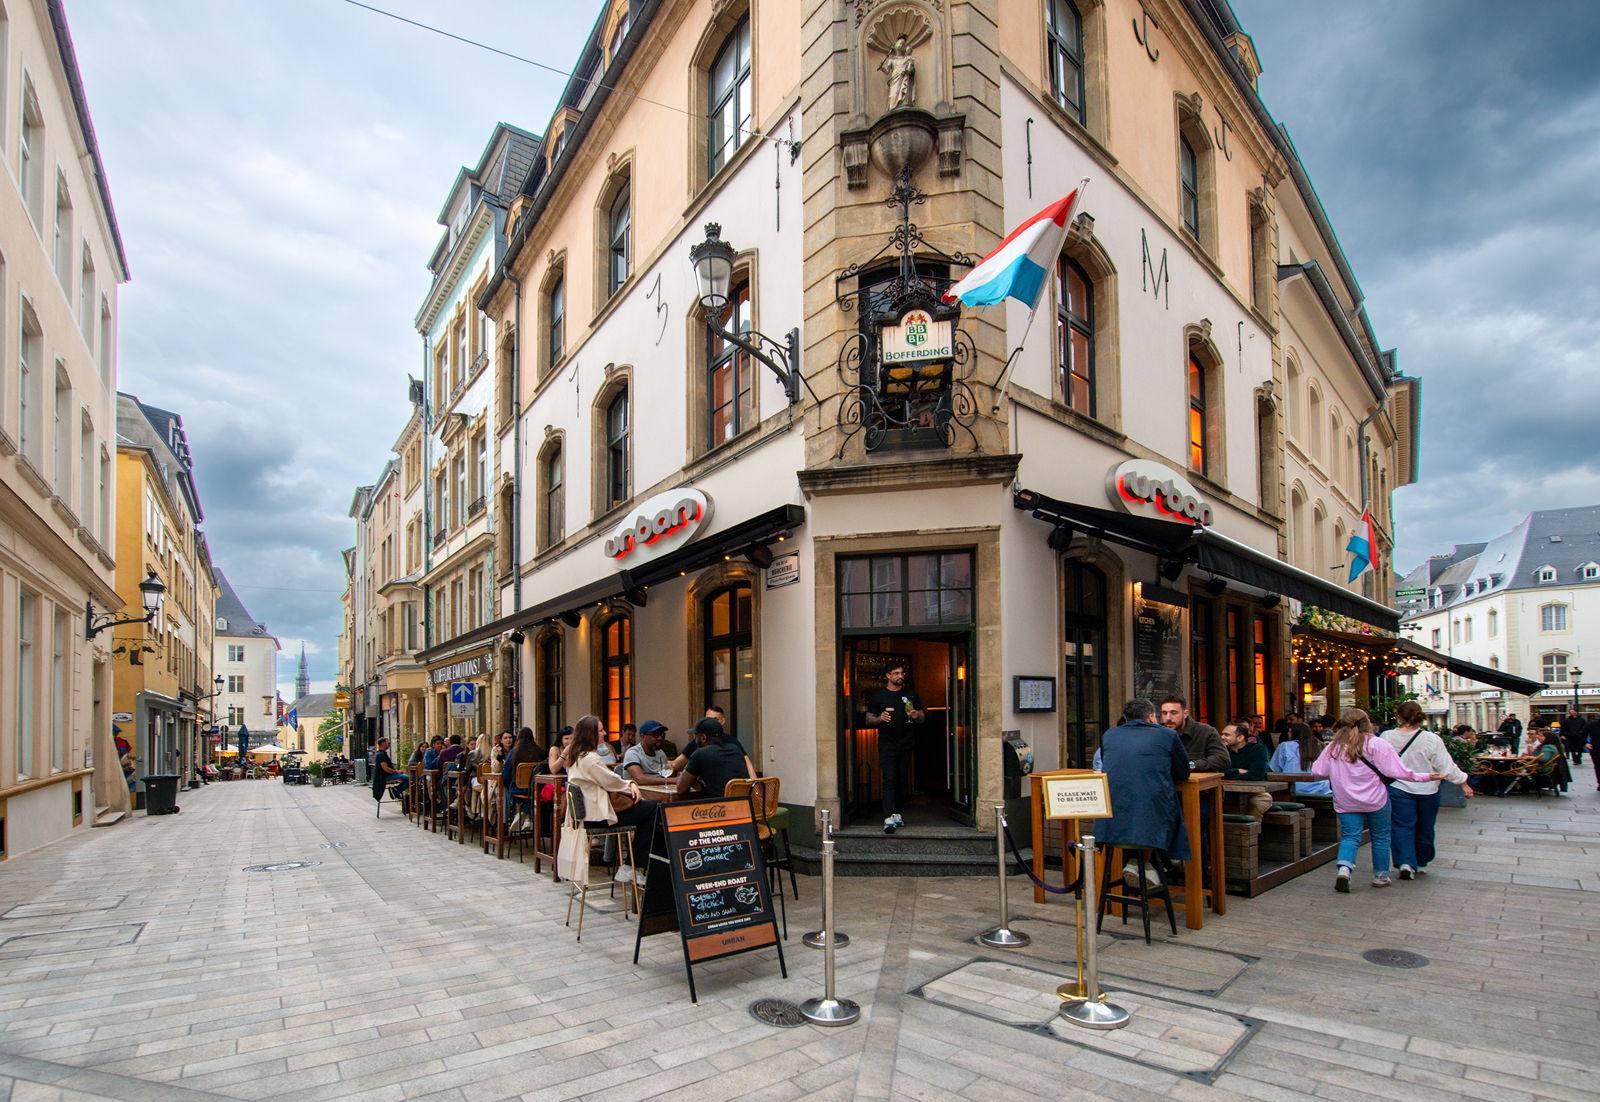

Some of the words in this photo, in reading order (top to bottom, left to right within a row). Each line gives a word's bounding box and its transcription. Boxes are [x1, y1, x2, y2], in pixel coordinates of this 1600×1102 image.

[885, 347, 949, 360] BOFFERDING
[1124, 471, 1214, 527] urban
[604, 498, 698, 558] urban
[772, 564, 792, 576] BOUCHERIE
[1139, 616, 1156, 625] KITCHEN
[434, 666, 452, 684] COIFFURE
[453, 658, 480, 680] EMOTIONS!
[699, 829, 724, 838] BURGER
[711, 834, 738, 844] MOMENT
[695, 880, 727, 890] WEEK-END
[727, 876, 747, 886] ROAST
[722, 936, 745, 945] URBAN
